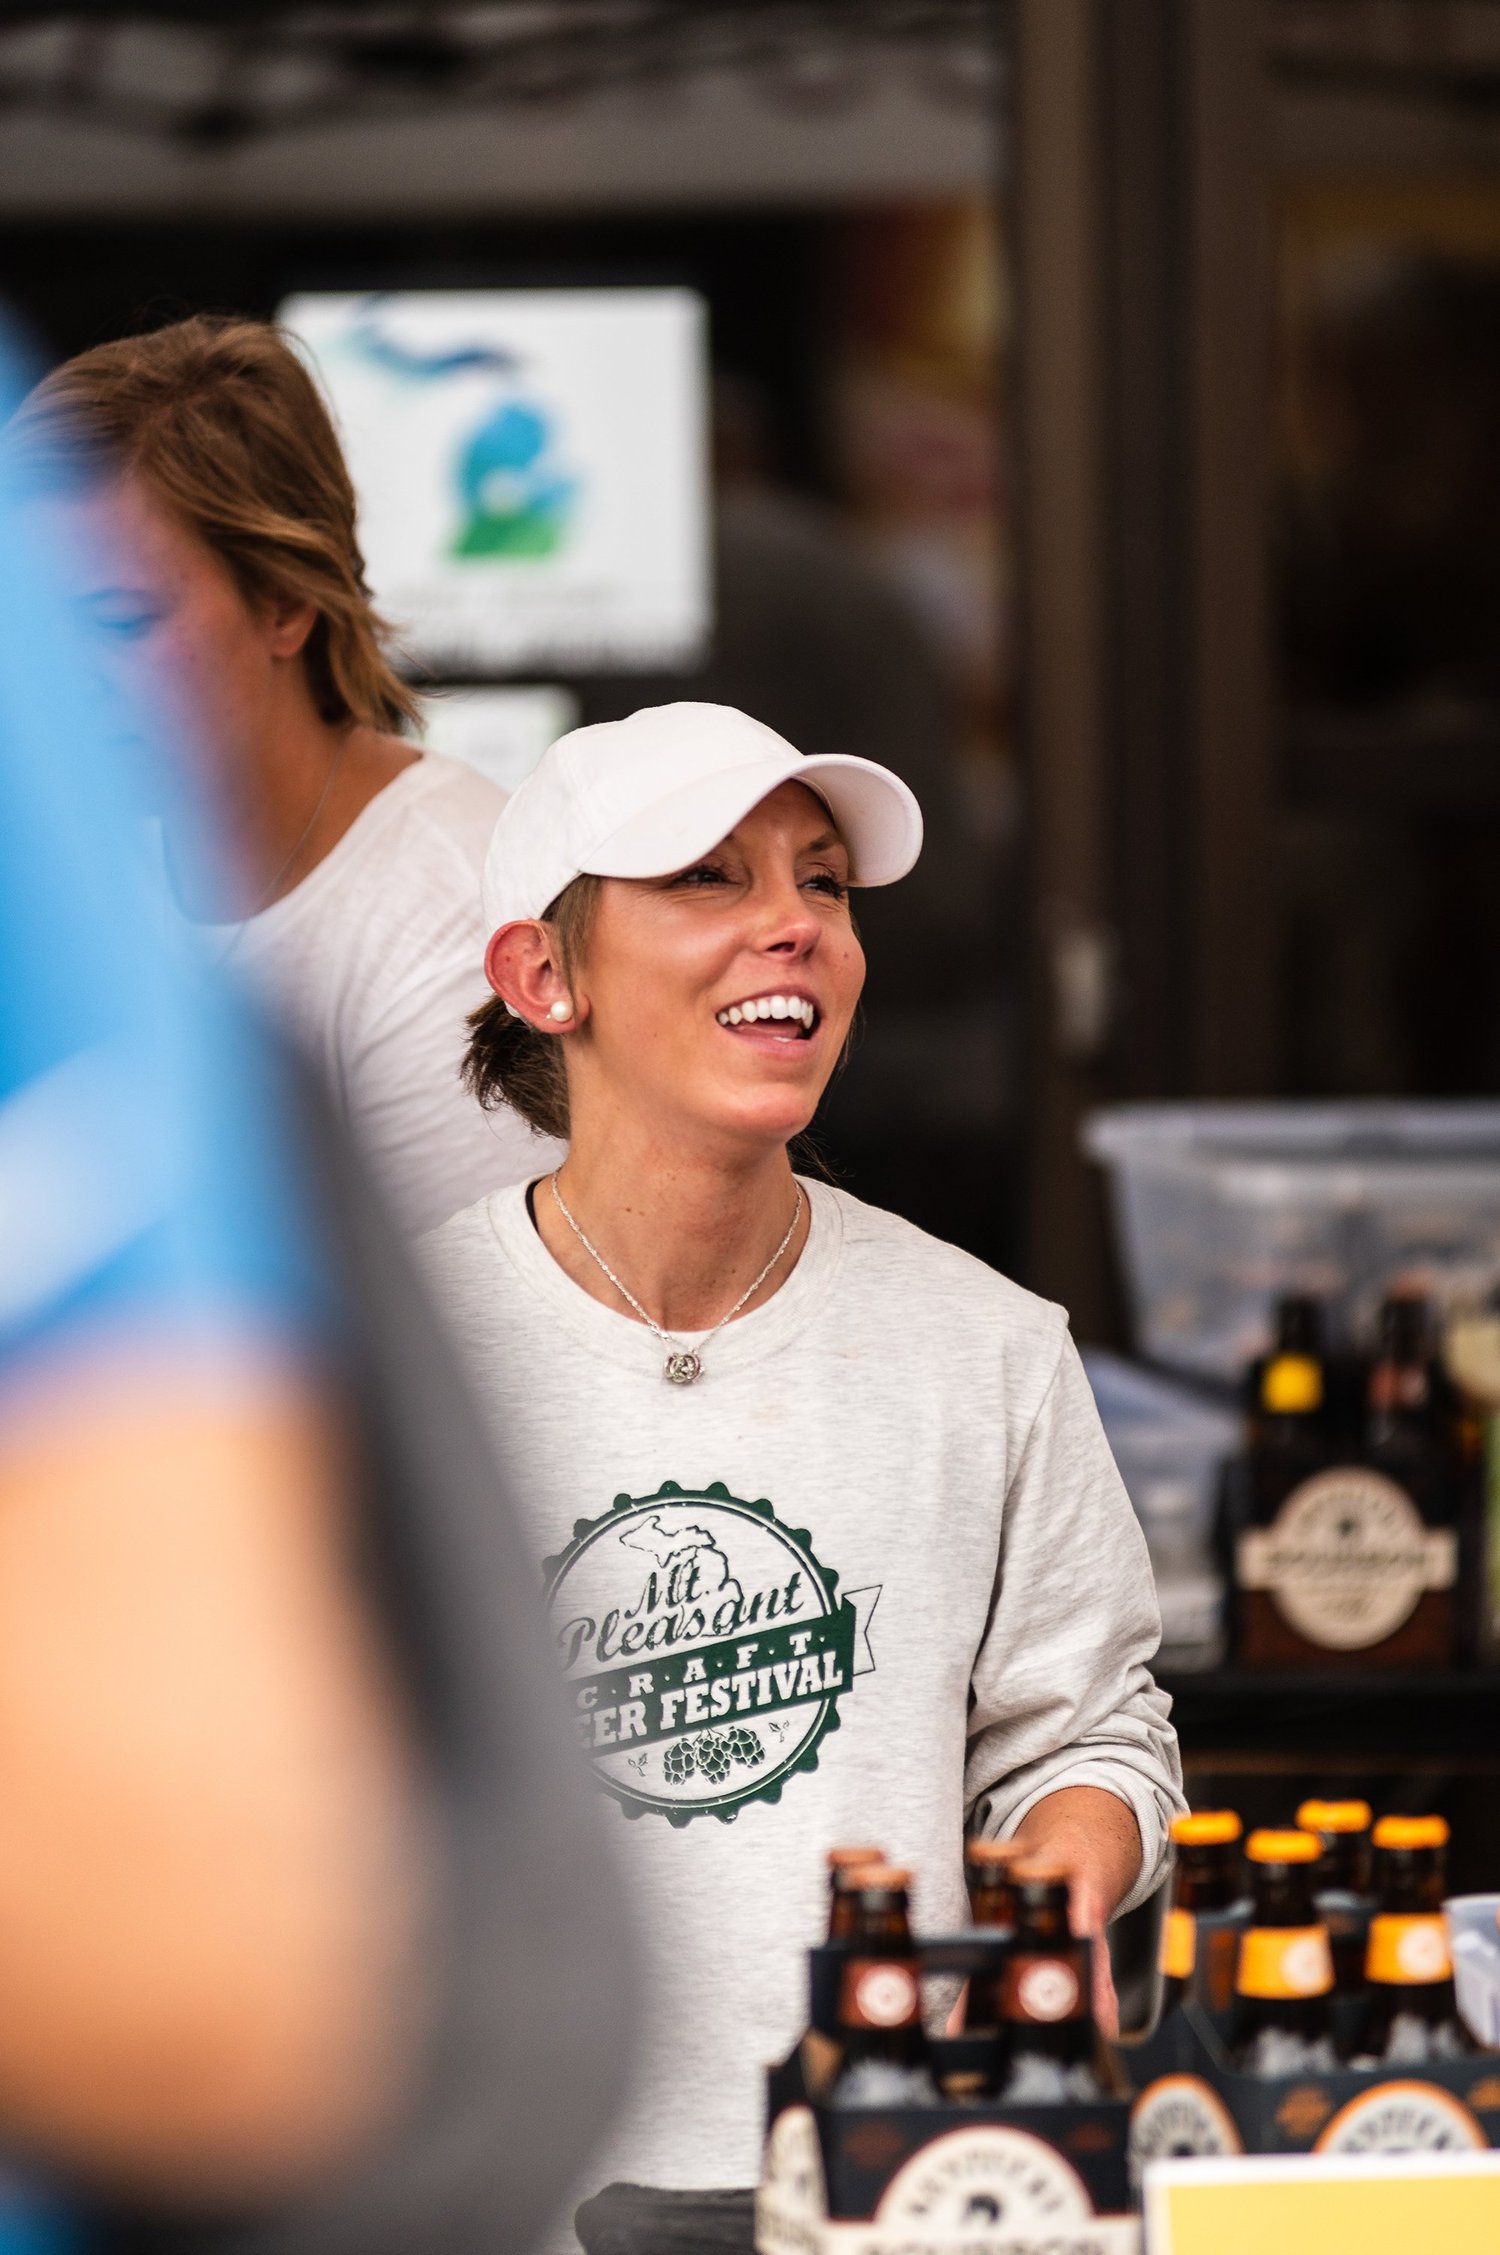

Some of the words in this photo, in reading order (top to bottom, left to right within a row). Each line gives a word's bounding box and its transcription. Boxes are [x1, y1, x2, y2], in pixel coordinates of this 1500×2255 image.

[559, 1571, 804, 1671] Pleasant
[624, 1564, 710, 1619] Mt.
[660, 1651, 843, 1731] FESTIVAL
